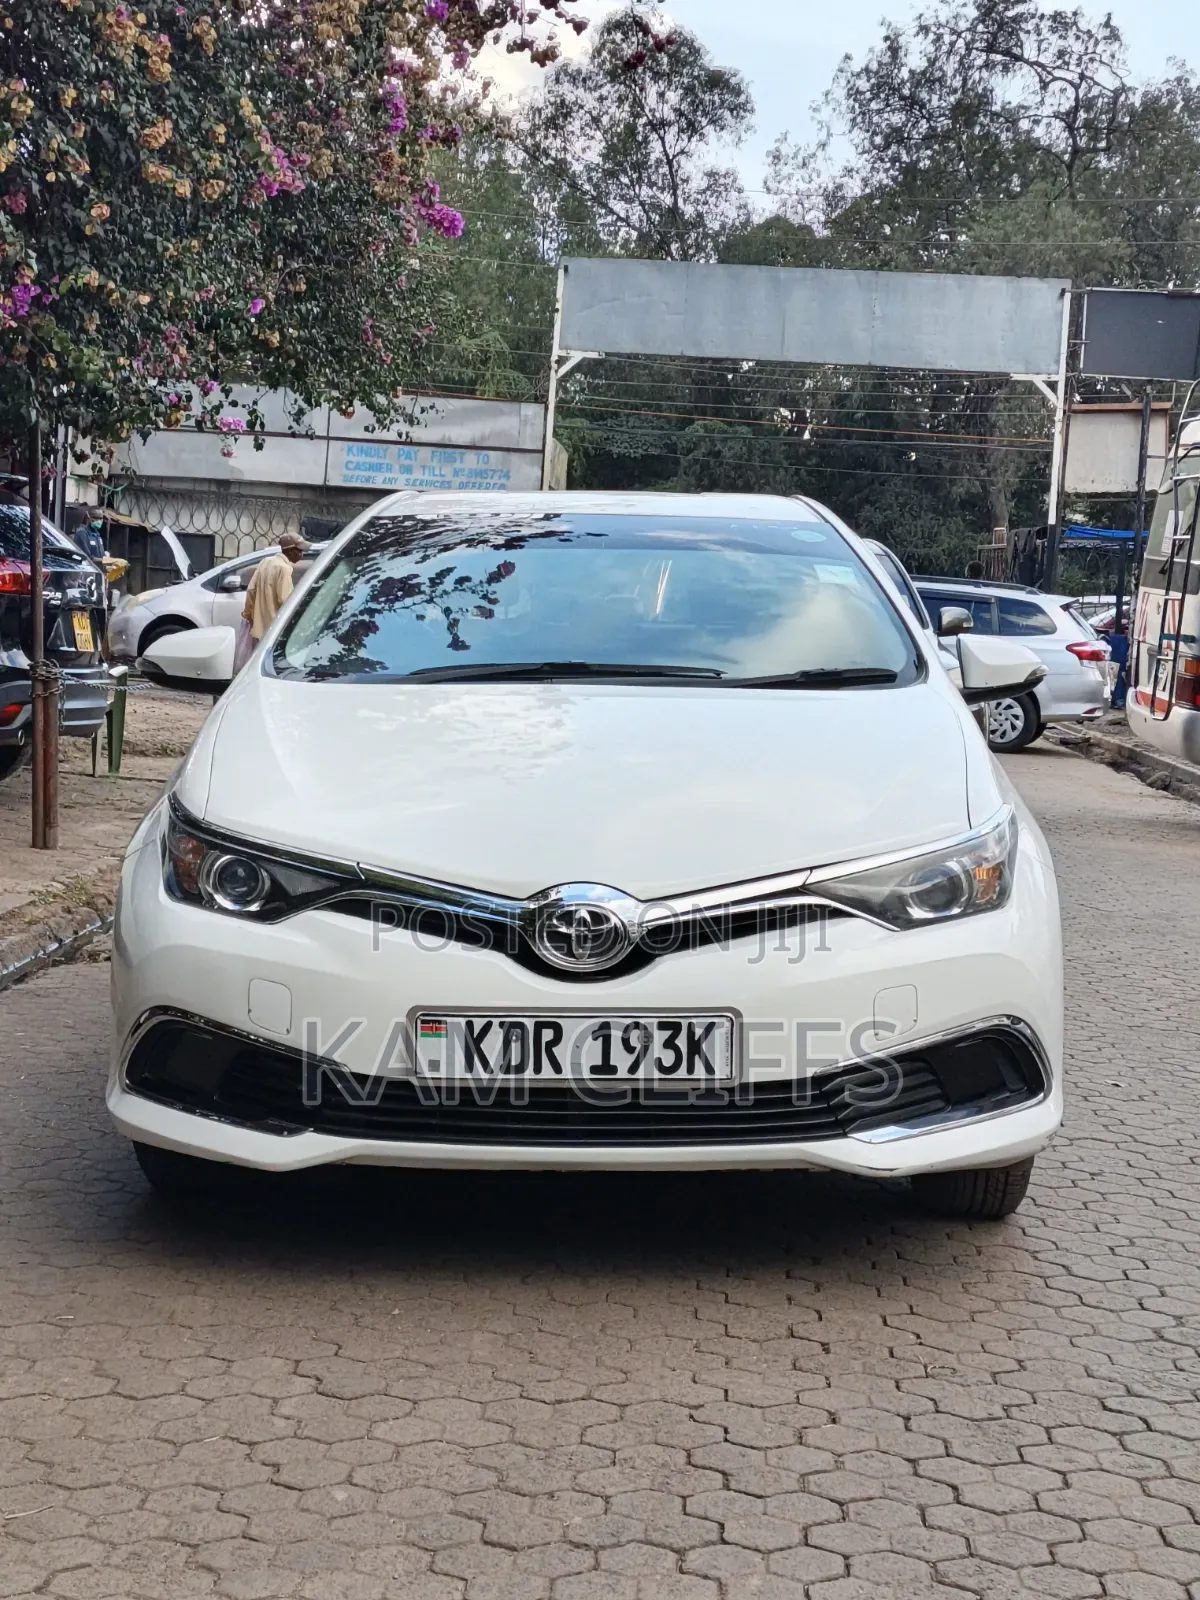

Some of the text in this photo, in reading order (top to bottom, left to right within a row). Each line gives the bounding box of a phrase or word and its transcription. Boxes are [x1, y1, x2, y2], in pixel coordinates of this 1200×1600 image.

[346, 445, 490, 464] KINDLY PAY FIRST TO
[344, 460, 393, 474] CASHIER
[399, 463, 413, 475] OR
[420, 465, 445, 477] TILL
[344, 475, 376, 485] BEFORE
[381, 477, 398, 486] ANY
[405, 479, 452, 489] SERVICES
[464, 1019, 563, 1076] KDR
[588, 1020, 717, 1076] 193K
